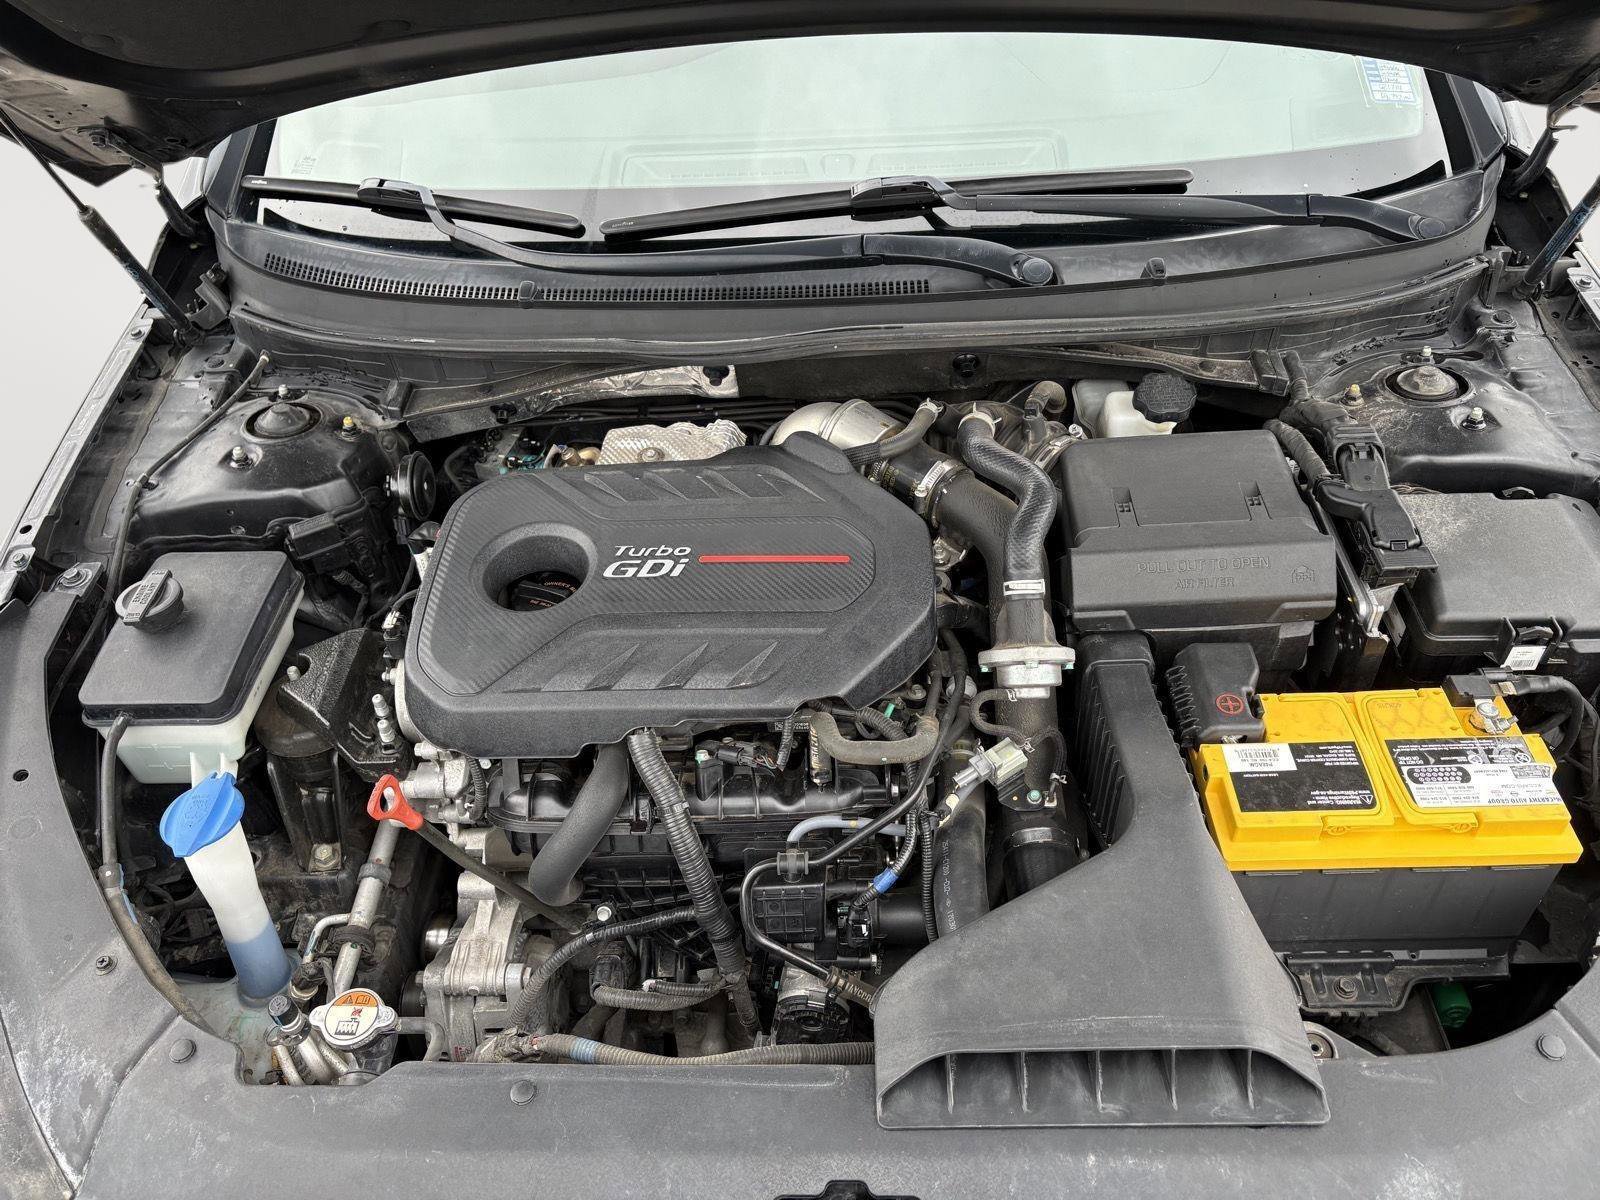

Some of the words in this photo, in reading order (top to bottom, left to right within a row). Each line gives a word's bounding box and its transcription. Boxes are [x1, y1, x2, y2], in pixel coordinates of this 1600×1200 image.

[614, 544, 692, 557] Turbo
[602, 558, 690, 578] GDi
[1136, 560, 1173, 575] PULL
[1177, 558, 1206, 573] OUT
[1211, 557, 1228, 571] TO
[1231, 556, 1271, 570] OPEN
